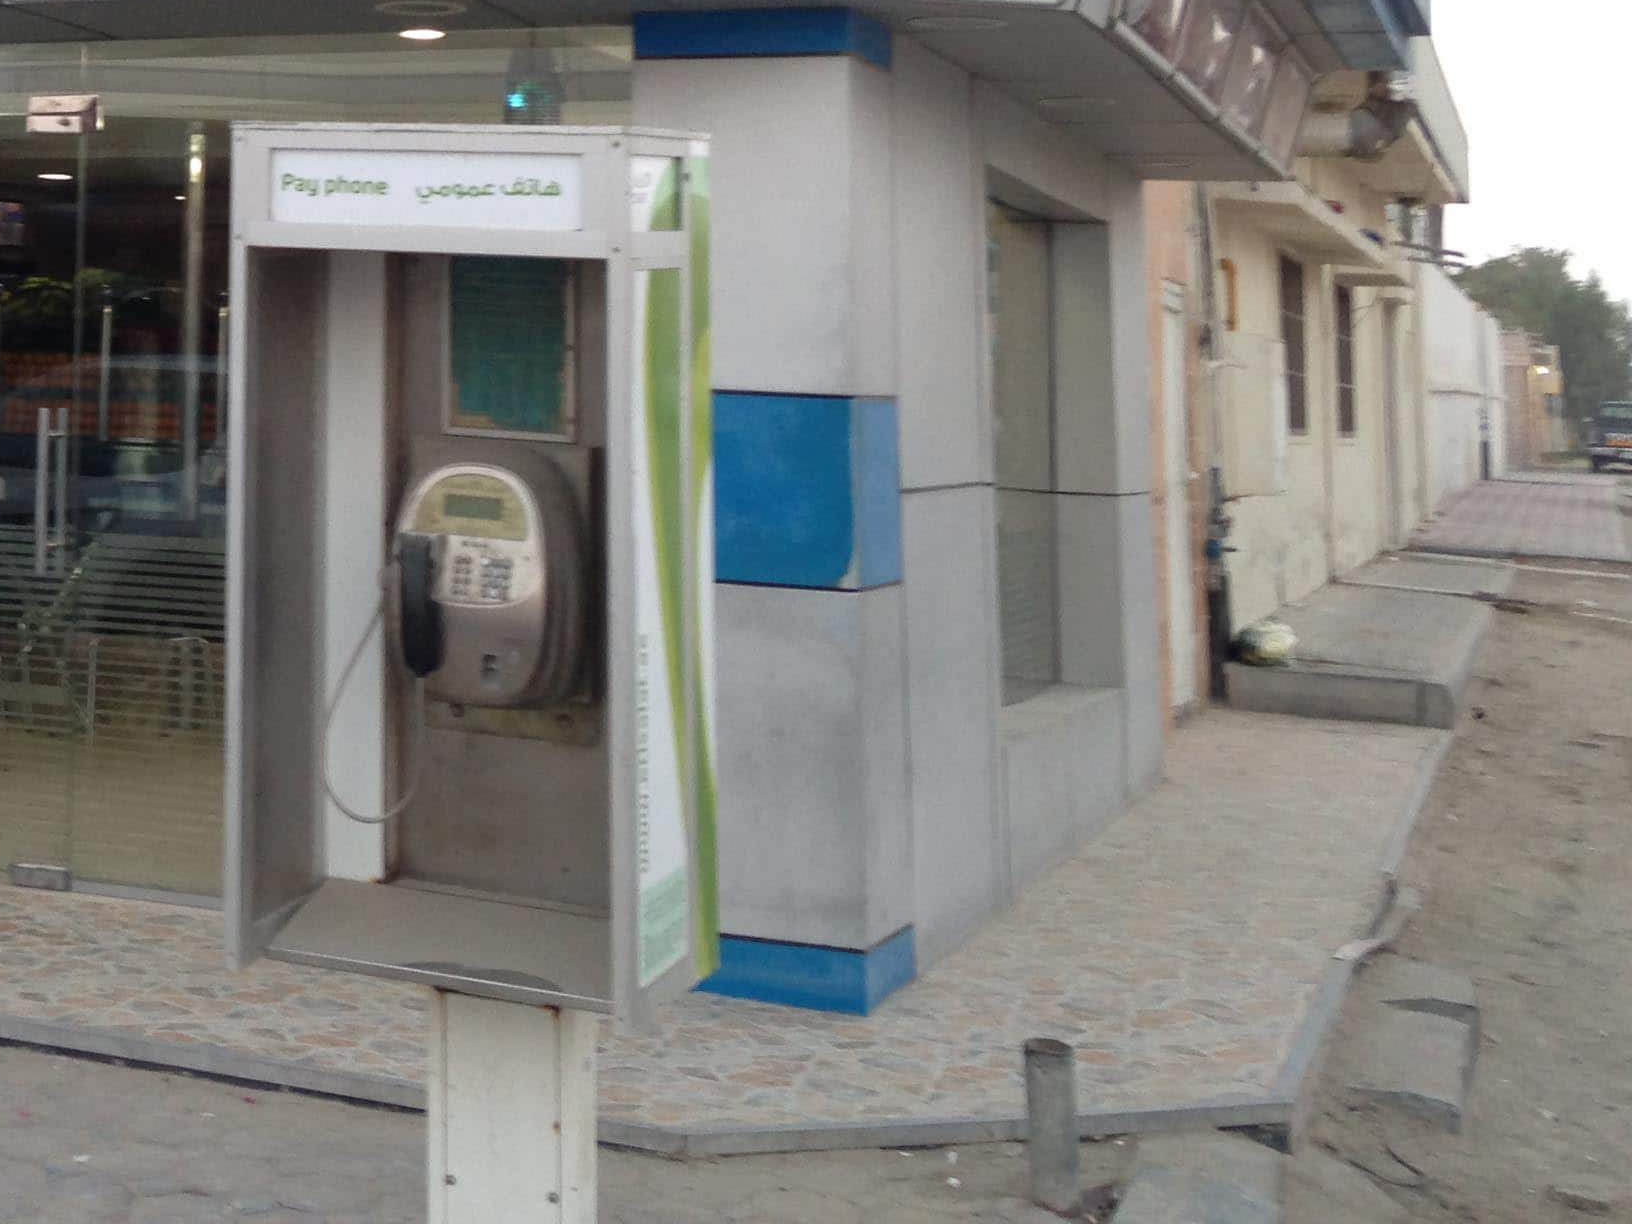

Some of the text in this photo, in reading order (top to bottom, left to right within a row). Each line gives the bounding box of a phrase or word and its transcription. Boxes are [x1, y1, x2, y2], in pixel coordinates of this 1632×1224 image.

[281, 173, 390, 197] Pay phone
[415, 176, 561, 205] هاتف عمومي
